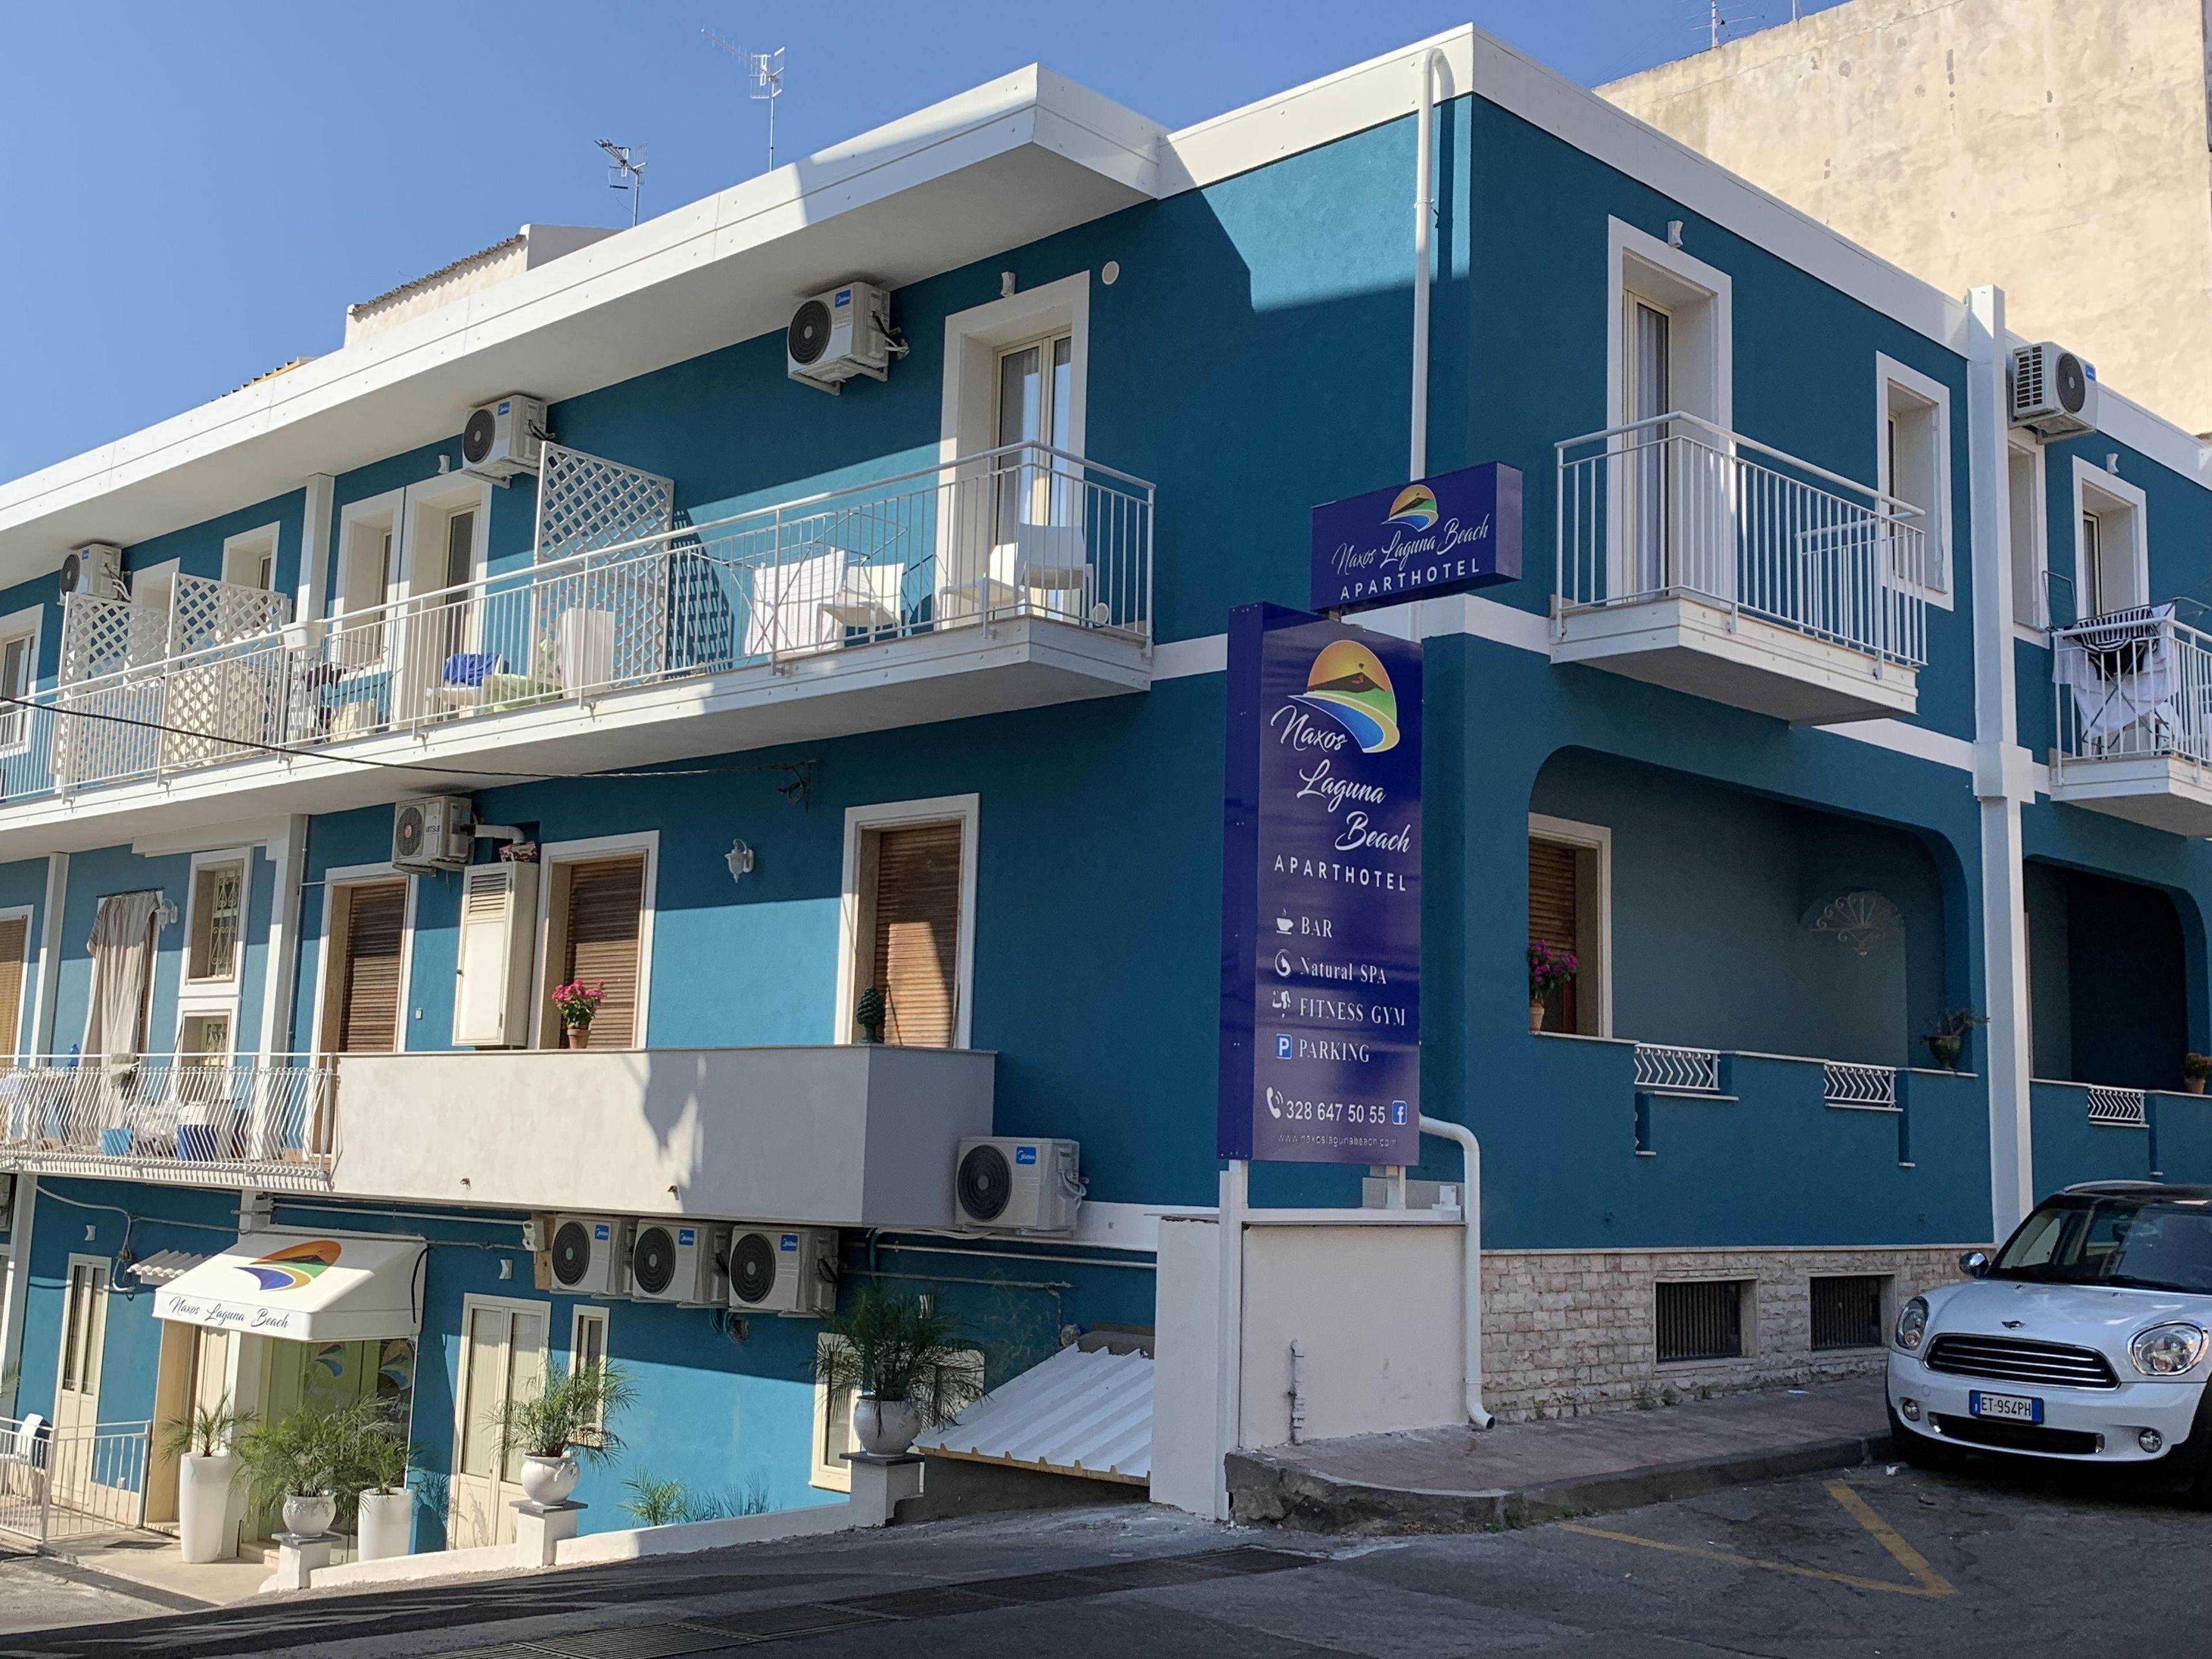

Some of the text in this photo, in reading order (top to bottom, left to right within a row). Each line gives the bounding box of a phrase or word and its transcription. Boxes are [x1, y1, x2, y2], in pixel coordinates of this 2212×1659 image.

[1332, 513, 1490, 575] Naxos Laguna Beach
[1340, 558, 1479, 600] APARTHOTEL
[1270, 704, 1348, 752] Naxos
[1297, 759, 1386, 813] Laguna
[1335, 811, 1411, 853] Beach
[1274, 855, 1406, 891] APARTHOTEL
[1301, 916, 1332, 938] BAR
[1300, 957, 1387, 984] Natural SPA
[1300, 998, 1405, 1025] FITNESS GYM
[1300, 1039, 1369, 1062] PARKING
[1286, 1100, 1312, 1120] 328
[1317, 1103, 1343, 1121] 647
[1348, 1105, 1364, 1123] 50
[1369, 1105, 1385, 1123] 55
[1278, 1134, 1397, 1147] wwwnaxoslagunabeachcom
[169, 1296, 289, 1328] Naxos Laguna Beach
